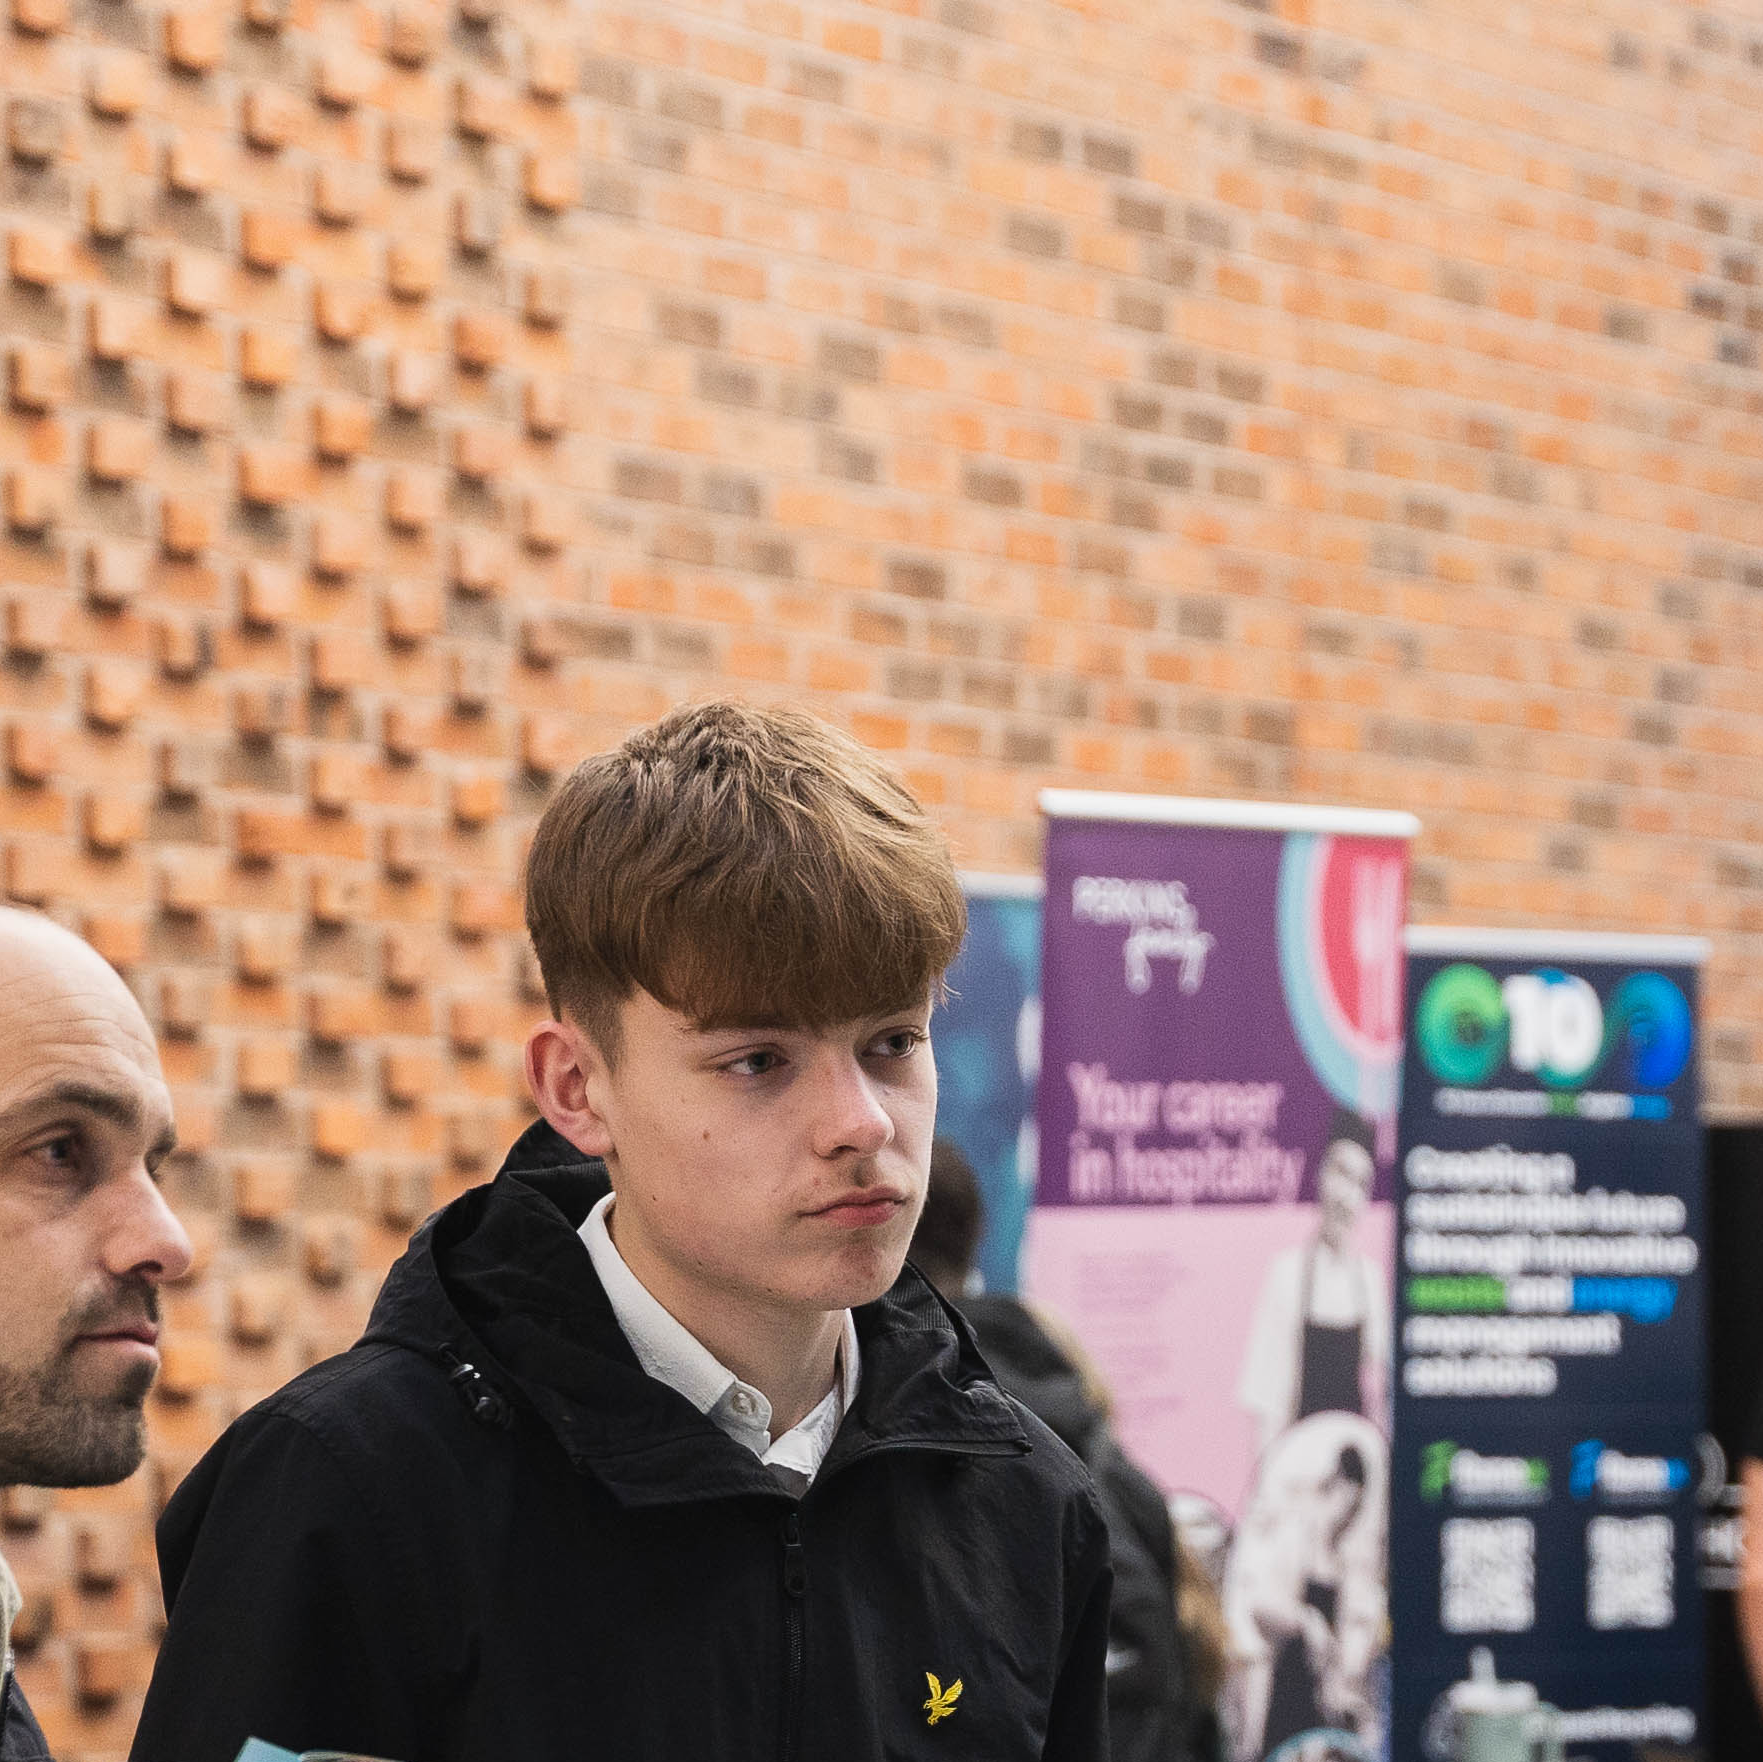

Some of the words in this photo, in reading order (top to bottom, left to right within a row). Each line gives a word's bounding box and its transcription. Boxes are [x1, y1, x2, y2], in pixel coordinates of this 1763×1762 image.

[1067, 1062, 1160, 1132] Your
[1163, 1080, 1283, 1134] career
[1070, 1131, 1114, 1202] in
[1116, 1132, 1306, 1209] hospitality
[1406, 1191, 1585, 1234] sustainable
[1587, 1188, 1686, 1234] future
[1405, 1230, 1532, 1281] through
[1535, 1232, 1699, 1275] innovative
[1573, 1277, 1677, 1322] energy
[1404, 1314, 1621, 1358] management
[1404, 1355, 1557, 1396] solutions
